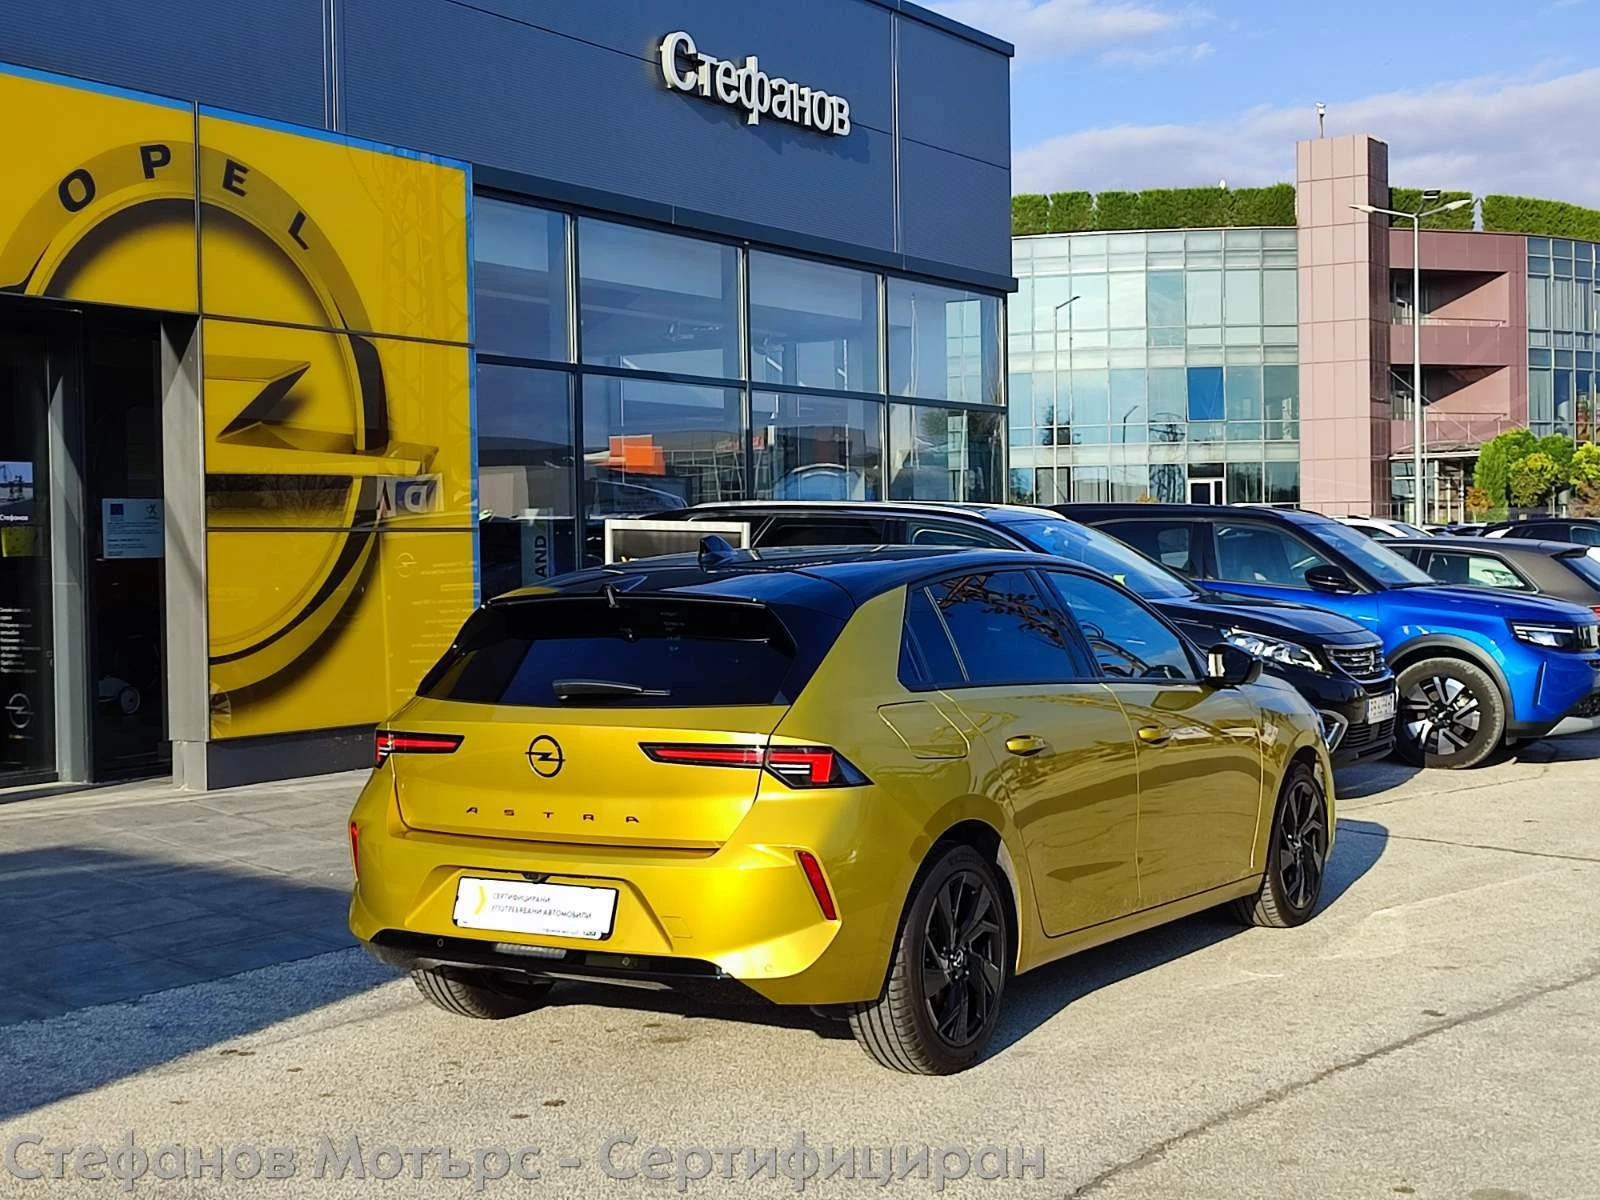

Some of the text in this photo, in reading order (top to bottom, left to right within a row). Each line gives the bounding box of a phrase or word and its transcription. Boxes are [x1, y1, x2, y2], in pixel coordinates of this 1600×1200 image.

[659, 31, 850, 136] Стефанов
[58, 144, 310, 251] OPEL
[466, 806, 640, 824] ASTRA
